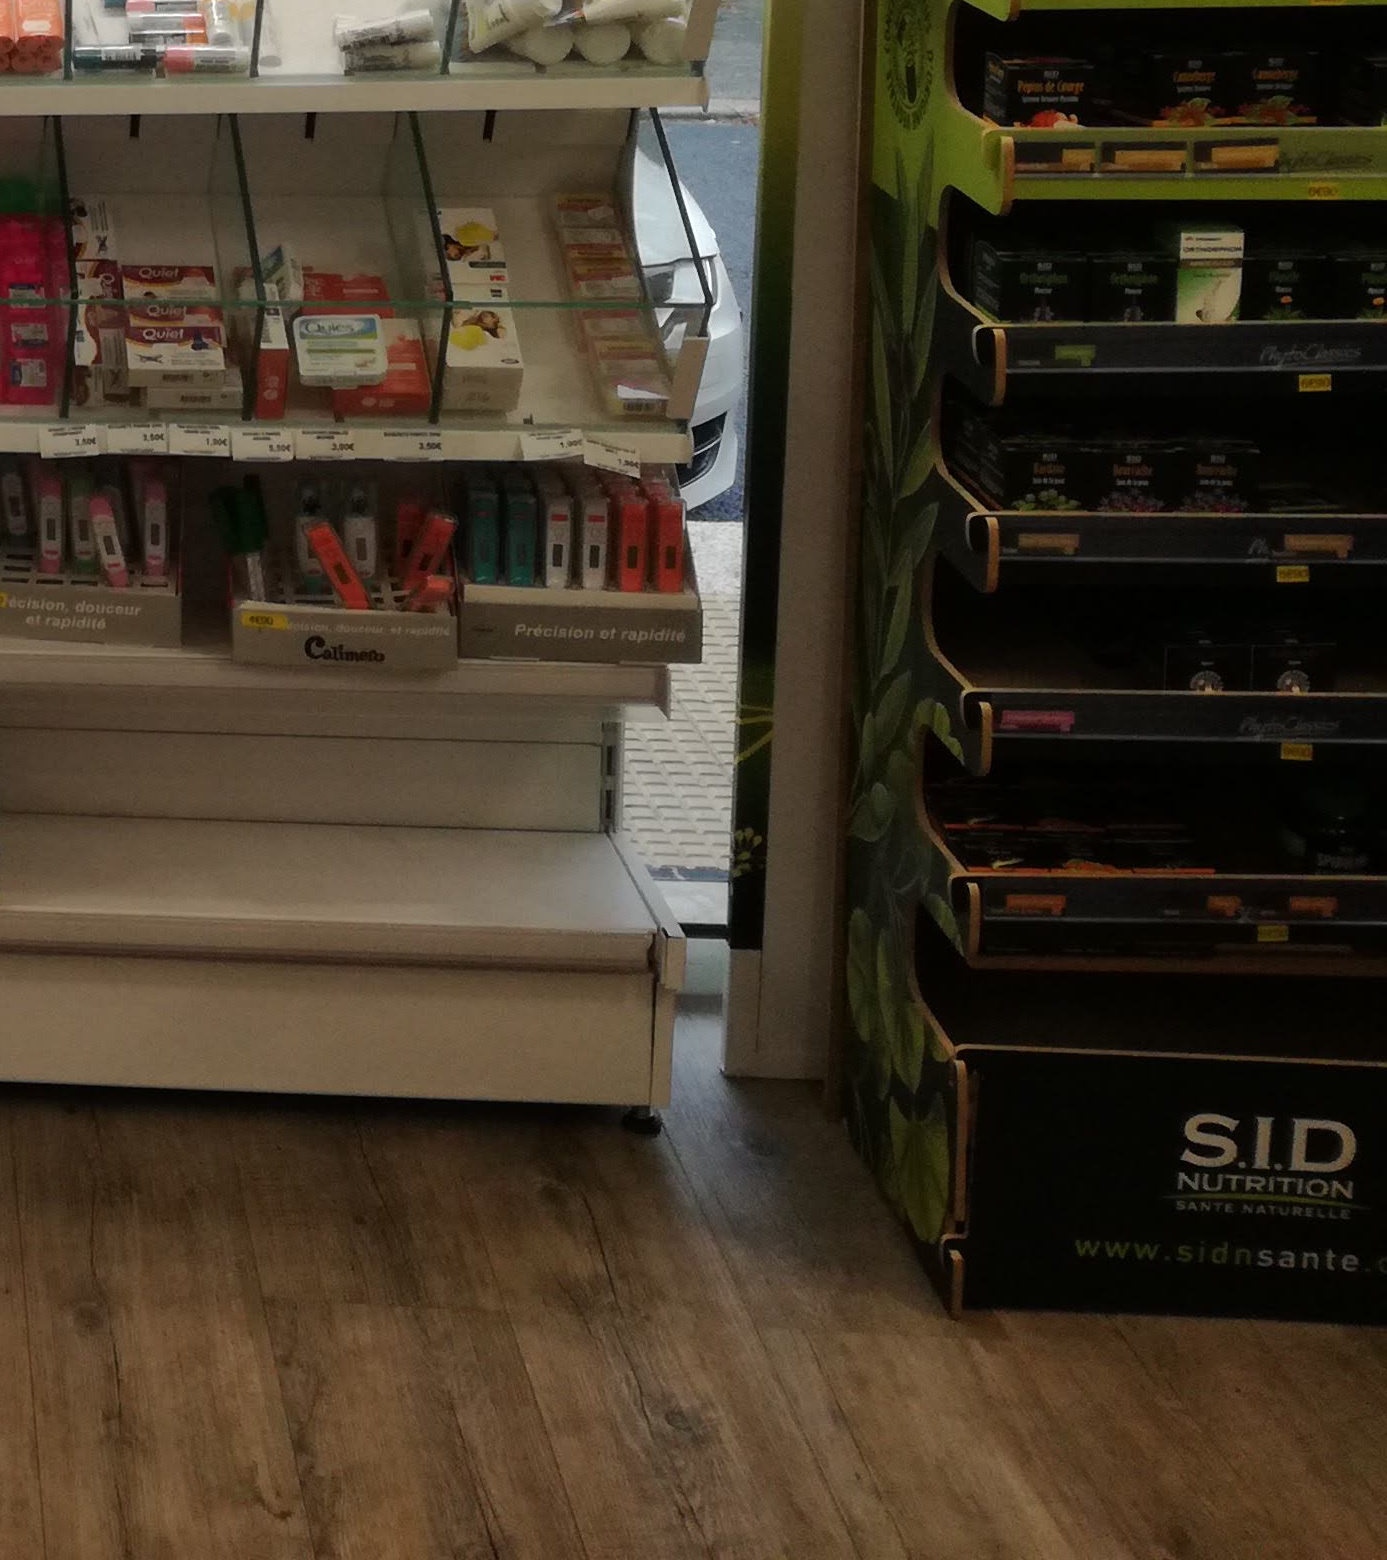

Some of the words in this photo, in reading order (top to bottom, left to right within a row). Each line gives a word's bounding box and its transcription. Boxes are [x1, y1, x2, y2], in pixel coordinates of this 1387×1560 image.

[8, 596, 70, 614] écision,
[74, 600, 142, 617] douceur
[514, 623, 595, 641] Précision
[599, 626, 617, 641] et
[620, 627, 687, 645] rapidité
[1176, 1171, 1354, 1200] NUTRITION
[1176, 1200, 1234, 1214] SANTE
[1242, 1202, 1352, 1221] NATURELLE
